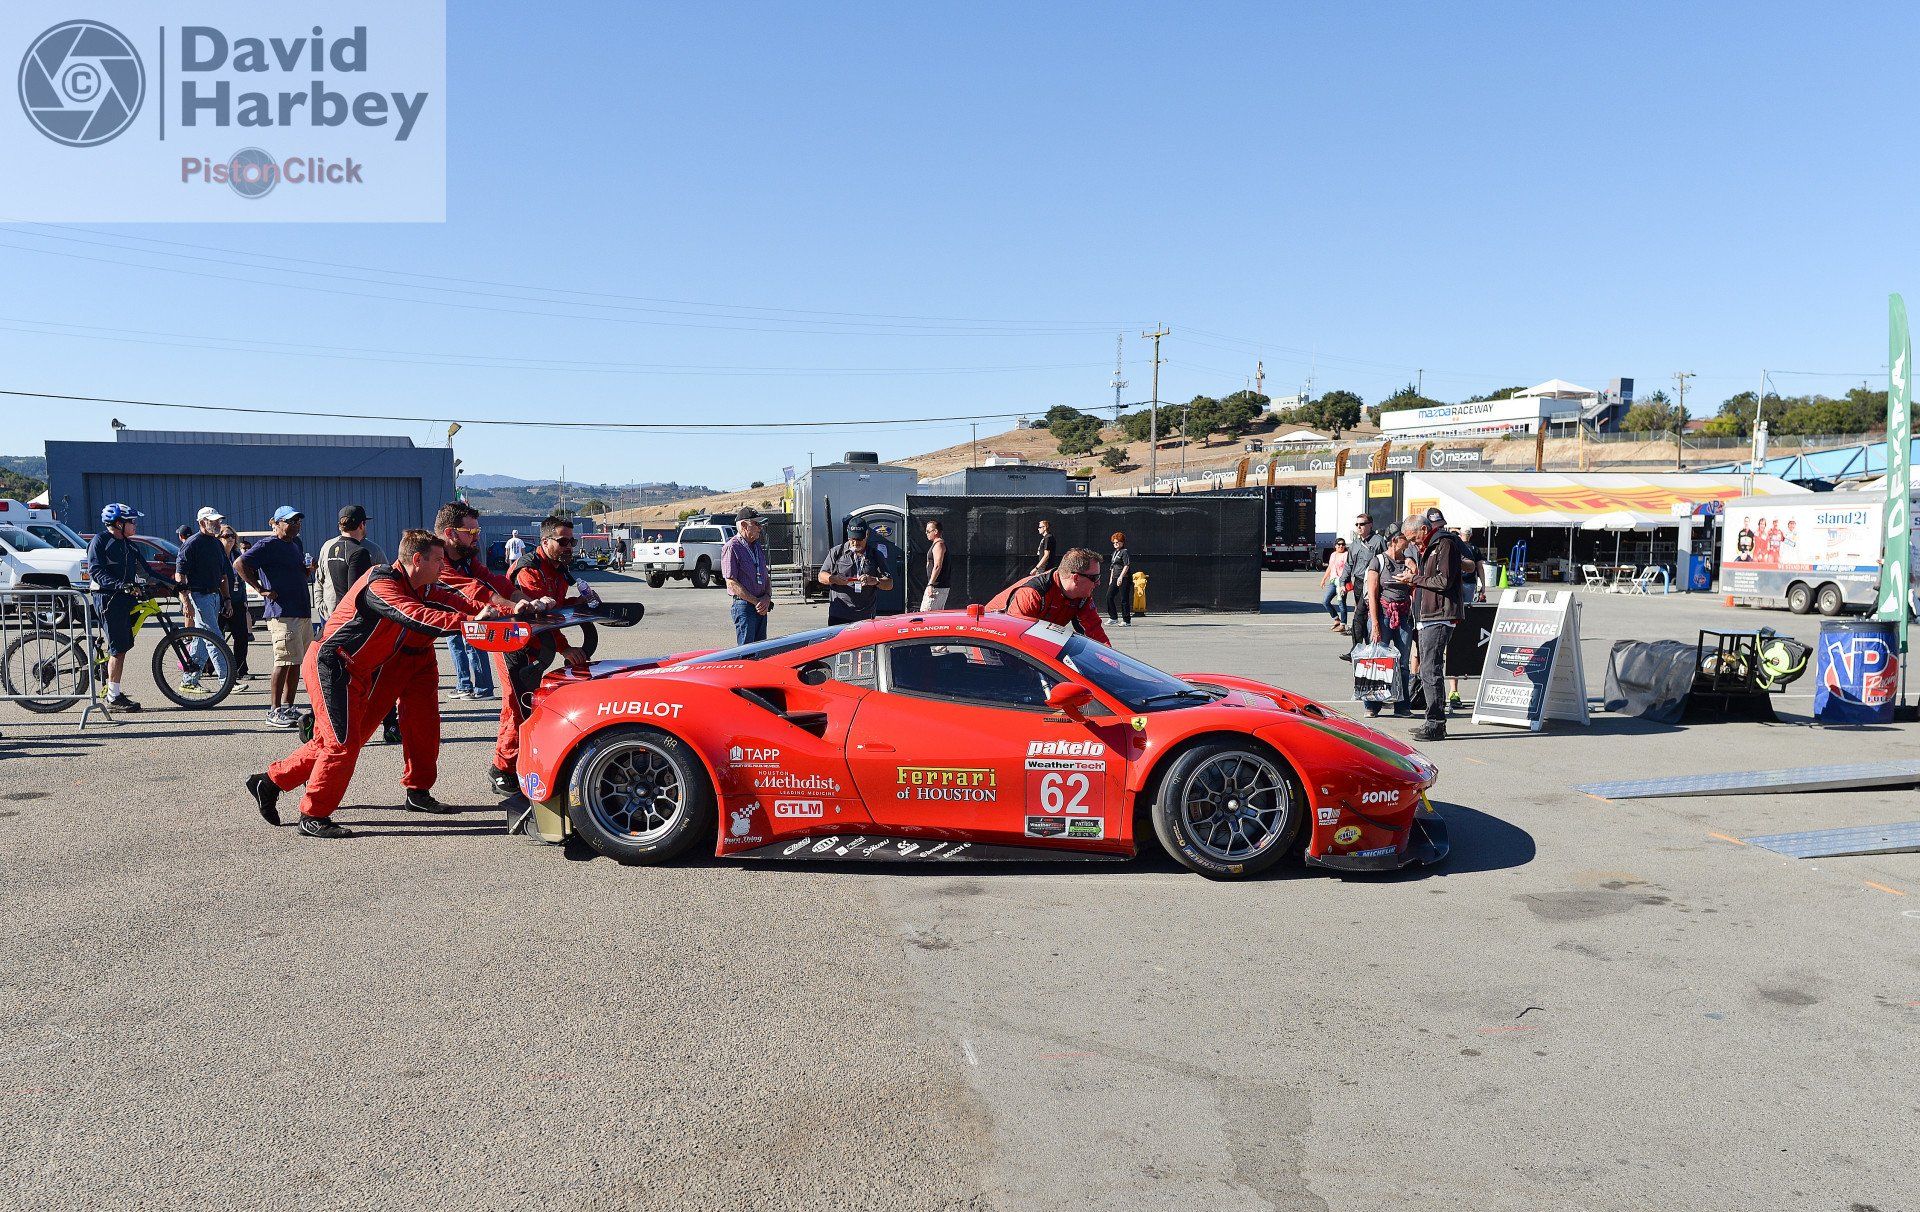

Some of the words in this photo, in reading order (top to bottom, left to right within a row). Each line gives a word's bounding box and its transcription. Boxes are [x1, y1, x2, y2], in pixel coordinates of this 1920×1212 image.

[1445, 451, 1479, 462] mazda
[1496, 622, 1559, 636] ENTRANCE
[1828, 637, 1890, 703] VP
[597, 701, 684, 718] HUBLOT
[745, 748, 780, 760] TAPP
[1027, 740, 1105, 757] pakelo
[1028, 761, 1104, 770] WeatherTech
[759, 774, 834, 789] Methodist
[897, 766, 996, 787] Ferrari
[896, 787, 910, 800] of
[917, 787, 997, 802] HOUSTON
[1040, 772, 1090, 814] 62
[776, 803, 821, 815] GTLM
[1362, 846, 1397, 857] MICHELIN
